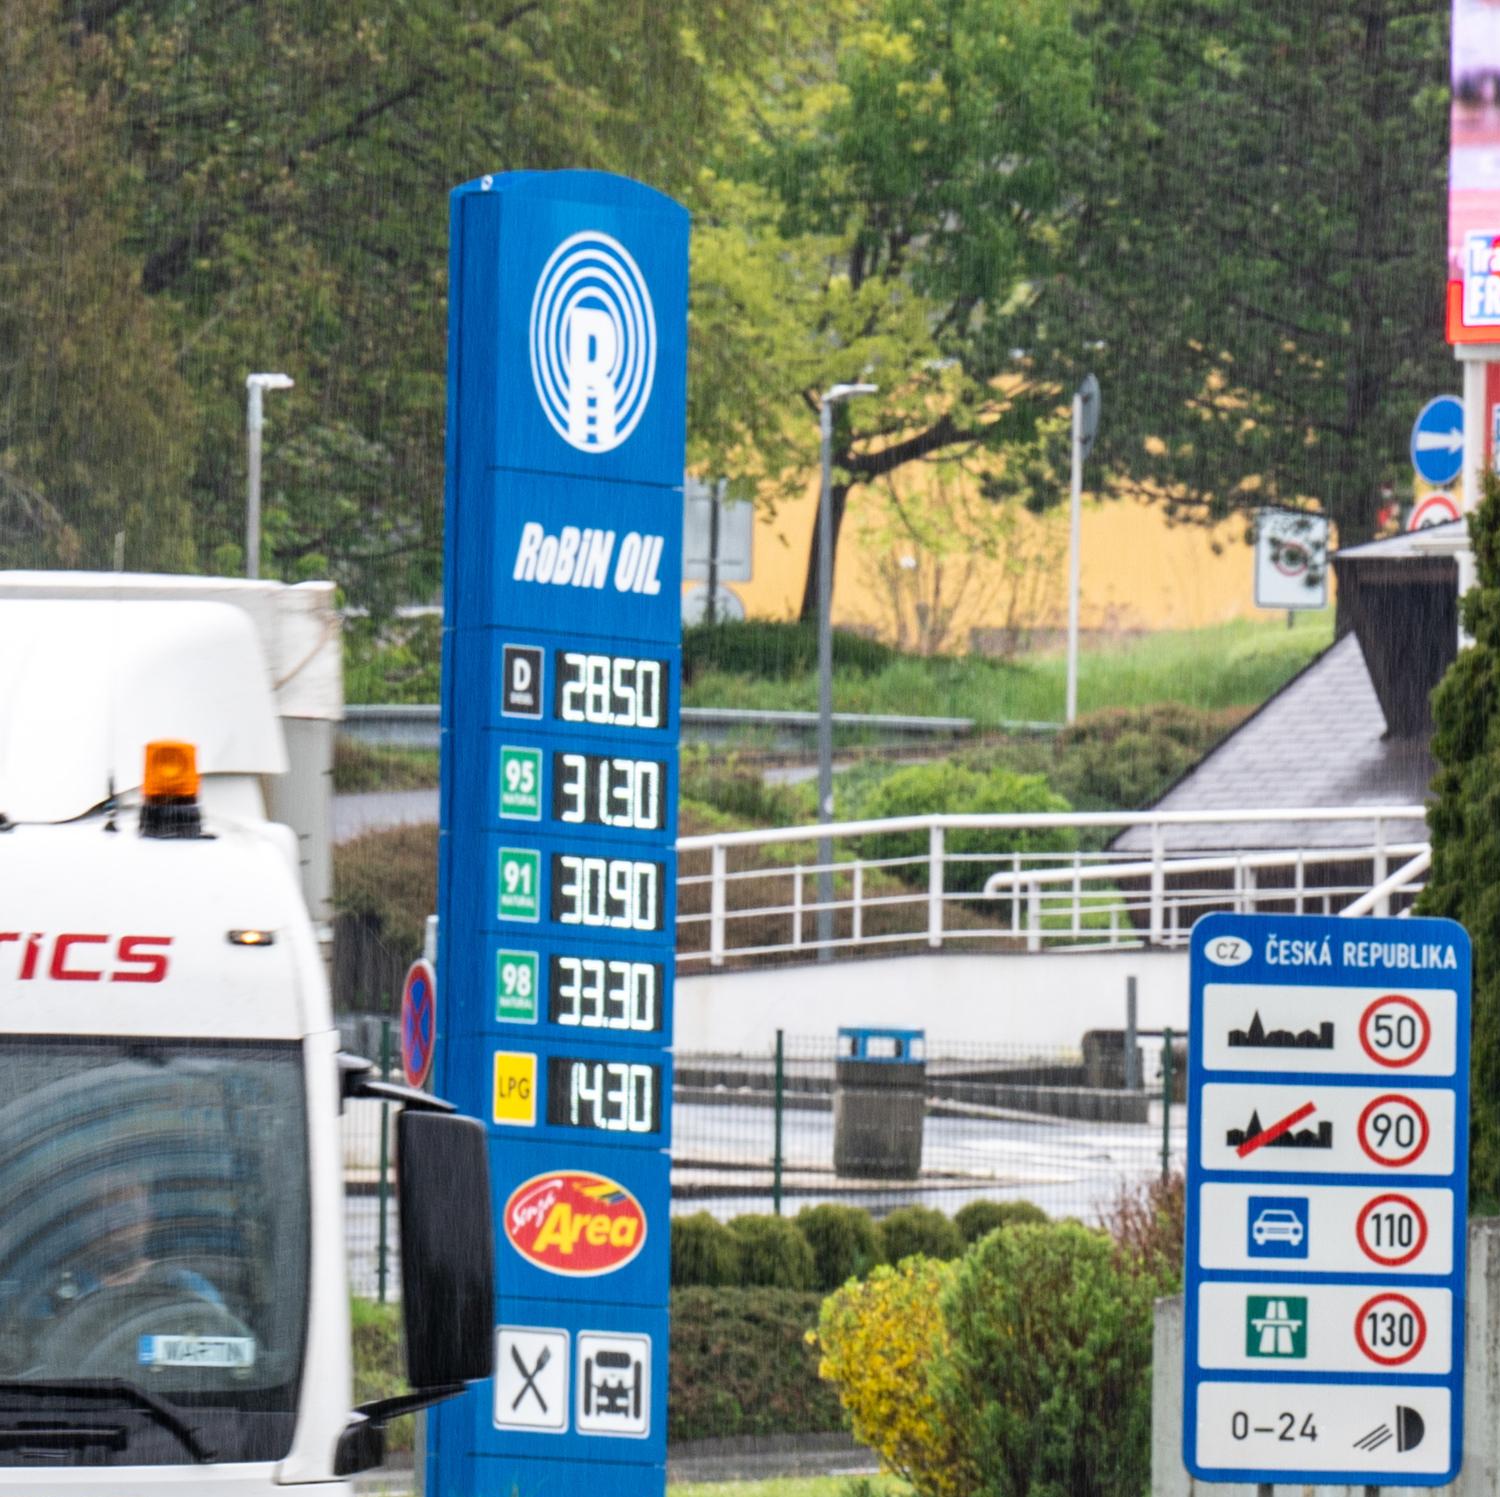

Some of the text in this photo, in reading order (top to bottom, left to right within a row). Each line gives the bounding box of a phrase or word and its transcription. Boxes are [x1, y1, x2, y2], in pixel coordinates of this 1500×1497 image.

[614, 531, 664, 596] OIL
[513, 657, 531, 692] D
[561, 652, 661, 728] 28.50
[505, 759, 535, 793] 95
[561, 753, 660, 830] 31.30
[503, 860, 532, 896] 91
[560, 856, 657, 931] 30.90
[1215, 942, 1241, 960] CZ
[1265, 933, 1458, 970] ČESKÁ REPUBLIKA
[501, 962, 532, 997] 98
[557, 956, 655, 1031] 33.30
[1373, 1013, 1416, 1049] 50
[499, 1075, 530, 1100] LPG
[569, 1061, 653, 1132] 14.30
[1371, 1112, 1415, 1149] 90
[532, 1202, 639, 1255] Area
[1370, 1212, 1413, 1248] 110
[1366, 1311, 1414, 1347] 130
